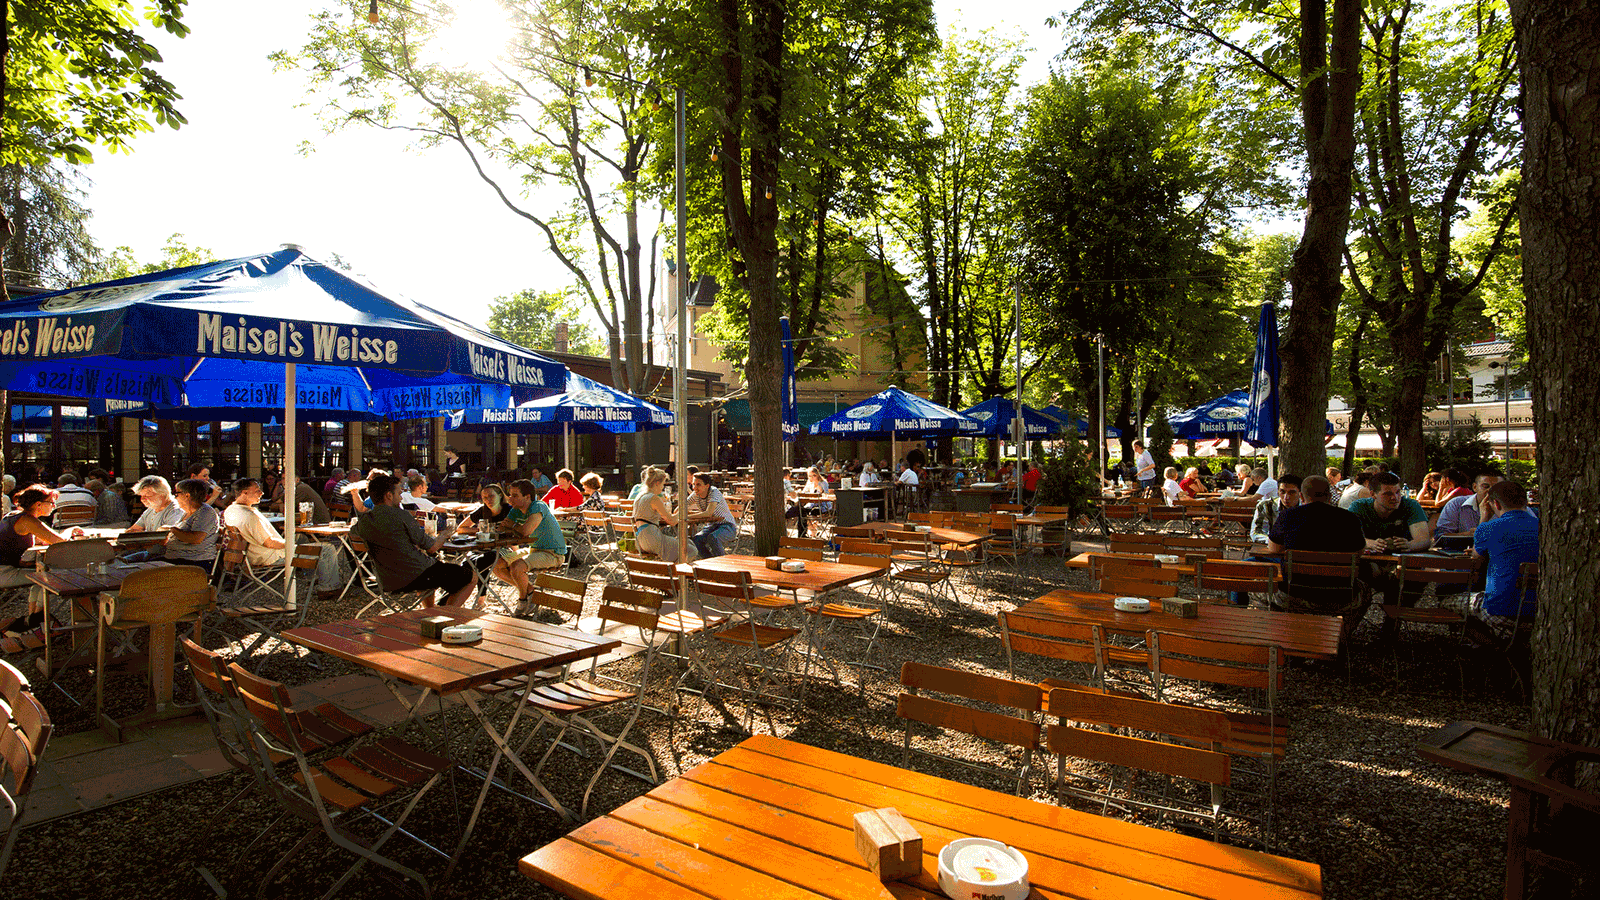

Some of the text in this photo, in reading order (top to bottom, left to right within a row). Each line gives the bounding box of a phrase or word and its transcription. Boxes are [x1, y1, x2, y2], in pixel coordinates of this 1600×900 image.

[0, 317, 95, 356] el's Weisse
[196, 312, 398, 364] Maisel's Weisse
[507, 354, 545, 386] Weisse
[482, 408, 542, 423] Maisel's Weisse
[573, 406, 632, 421] Maisel's Weisse
[894, 418, 942, 430] Maisel's Weisse
[1200, 421, 1247, 433] Maisel's Weiss
